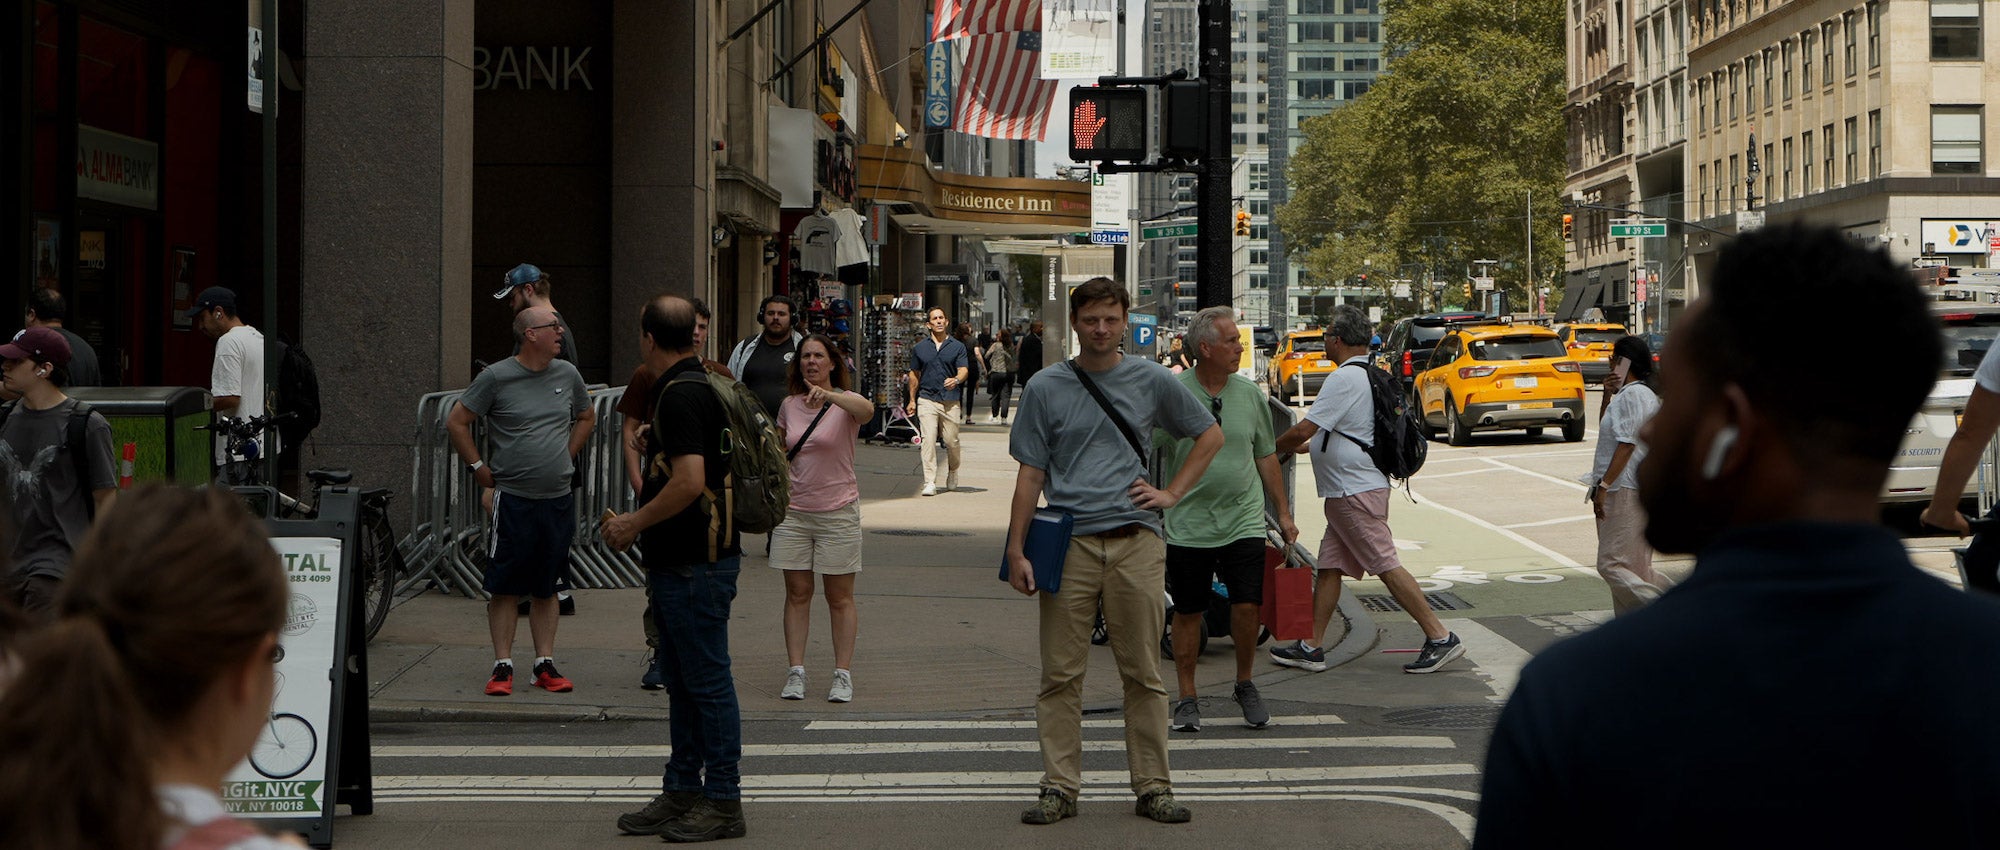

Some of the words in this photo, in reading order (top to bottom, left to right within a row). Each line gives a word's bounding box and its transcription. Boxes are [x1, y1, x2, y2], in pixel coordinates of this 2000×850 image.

[474, 46, 593, 90] BANK
[942, 188, 1014, 211] Residence
[1018, 195, 1053, 212] Inn
[1157, 228, 1164, 236] W
[1165, 227, 1175, 236] 39
[1176, 227, 1184, 235] St
[1624, 227, 1632, 235] W
[1632, 227, 1642, 235] 39
[1643, 227, 1651, 235] St
[1140, 327, 1151, 343] P
[1908, 448, 1943, 456] SECURITY
[249, 802, 267, 811] NY
[270, 801, 304, 811] 10018
